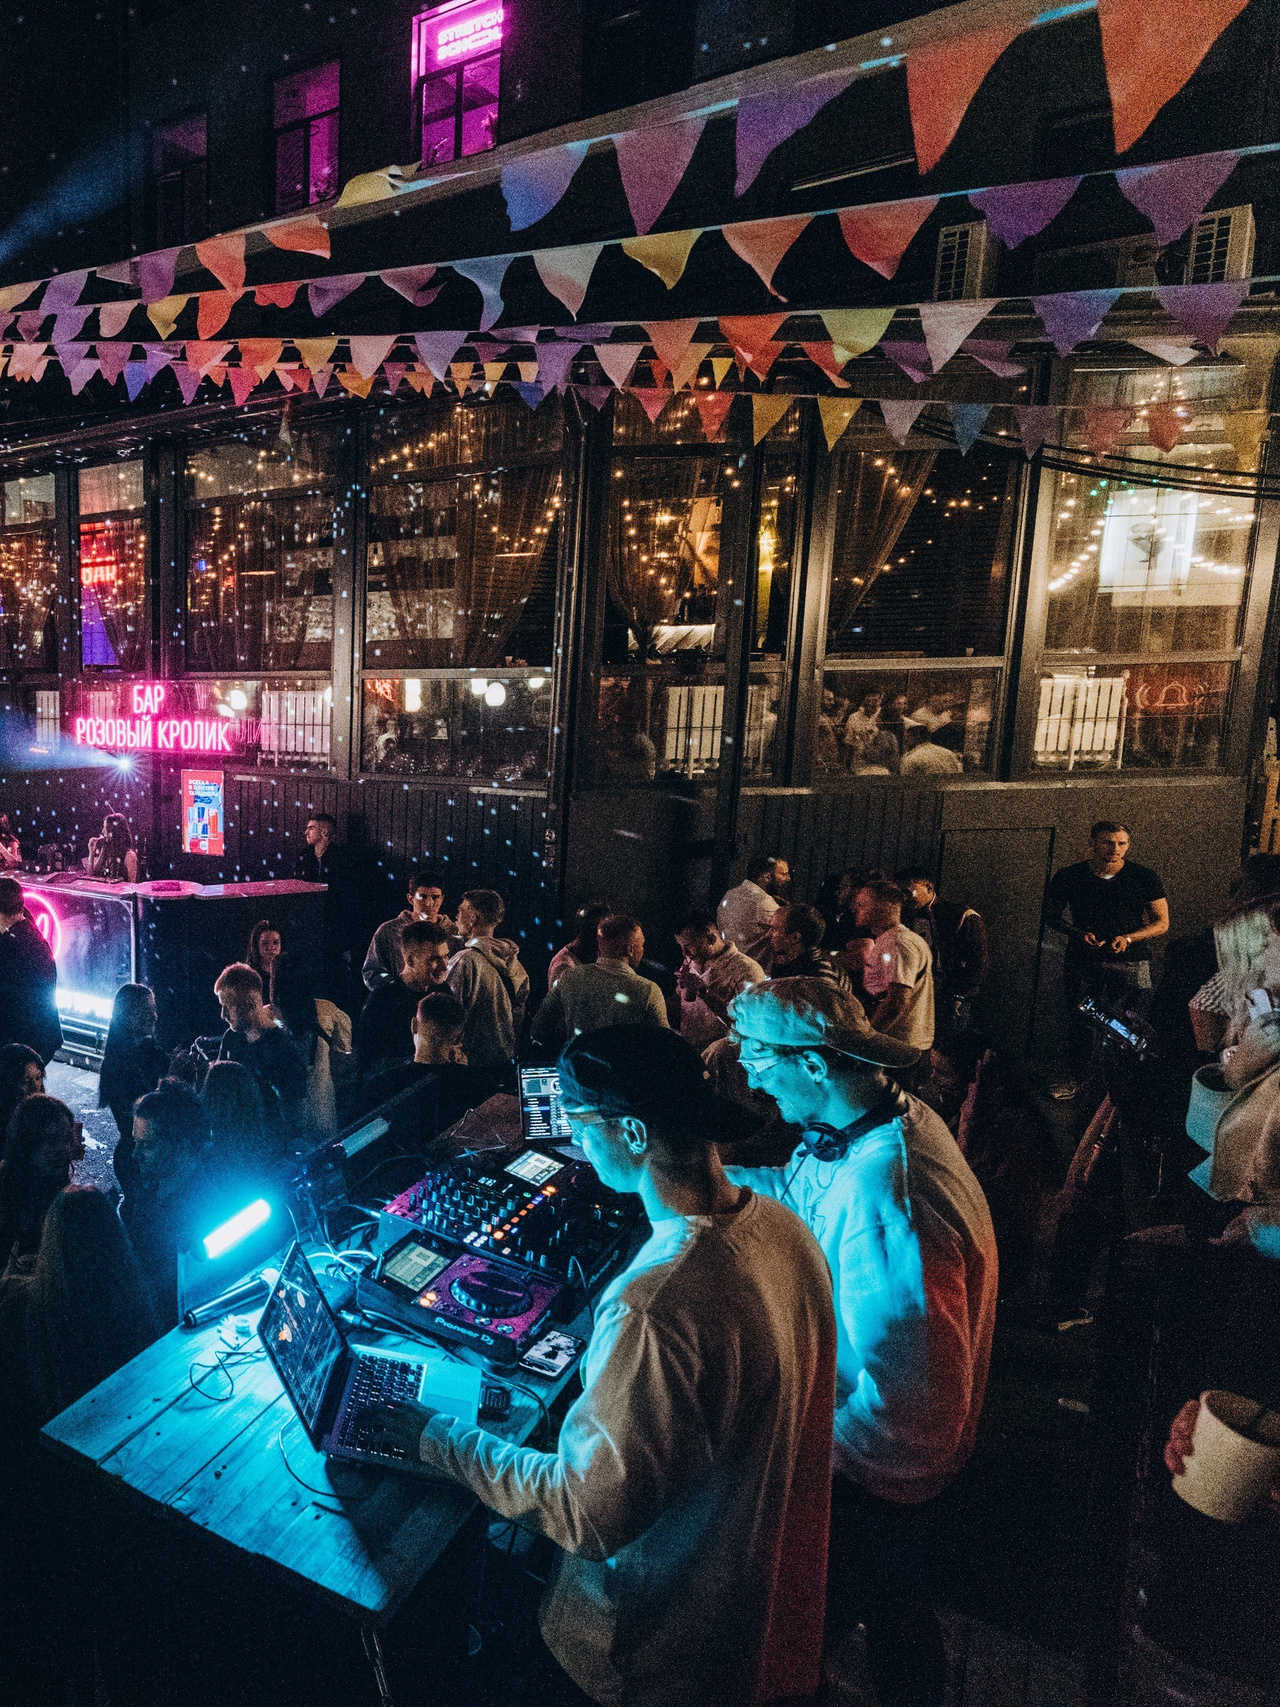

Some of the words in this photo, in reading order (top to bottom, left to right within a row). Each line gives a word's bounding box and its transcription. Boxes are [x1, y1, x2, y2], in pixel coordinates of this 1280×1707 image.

[132, 685, 165, 714] БАР
[75, 714, 153, 748] РОЗОВЫЙ
[157, 719, 232, 752] КРОЛИК
[434, 1316, 480, 1339] Pioneer
